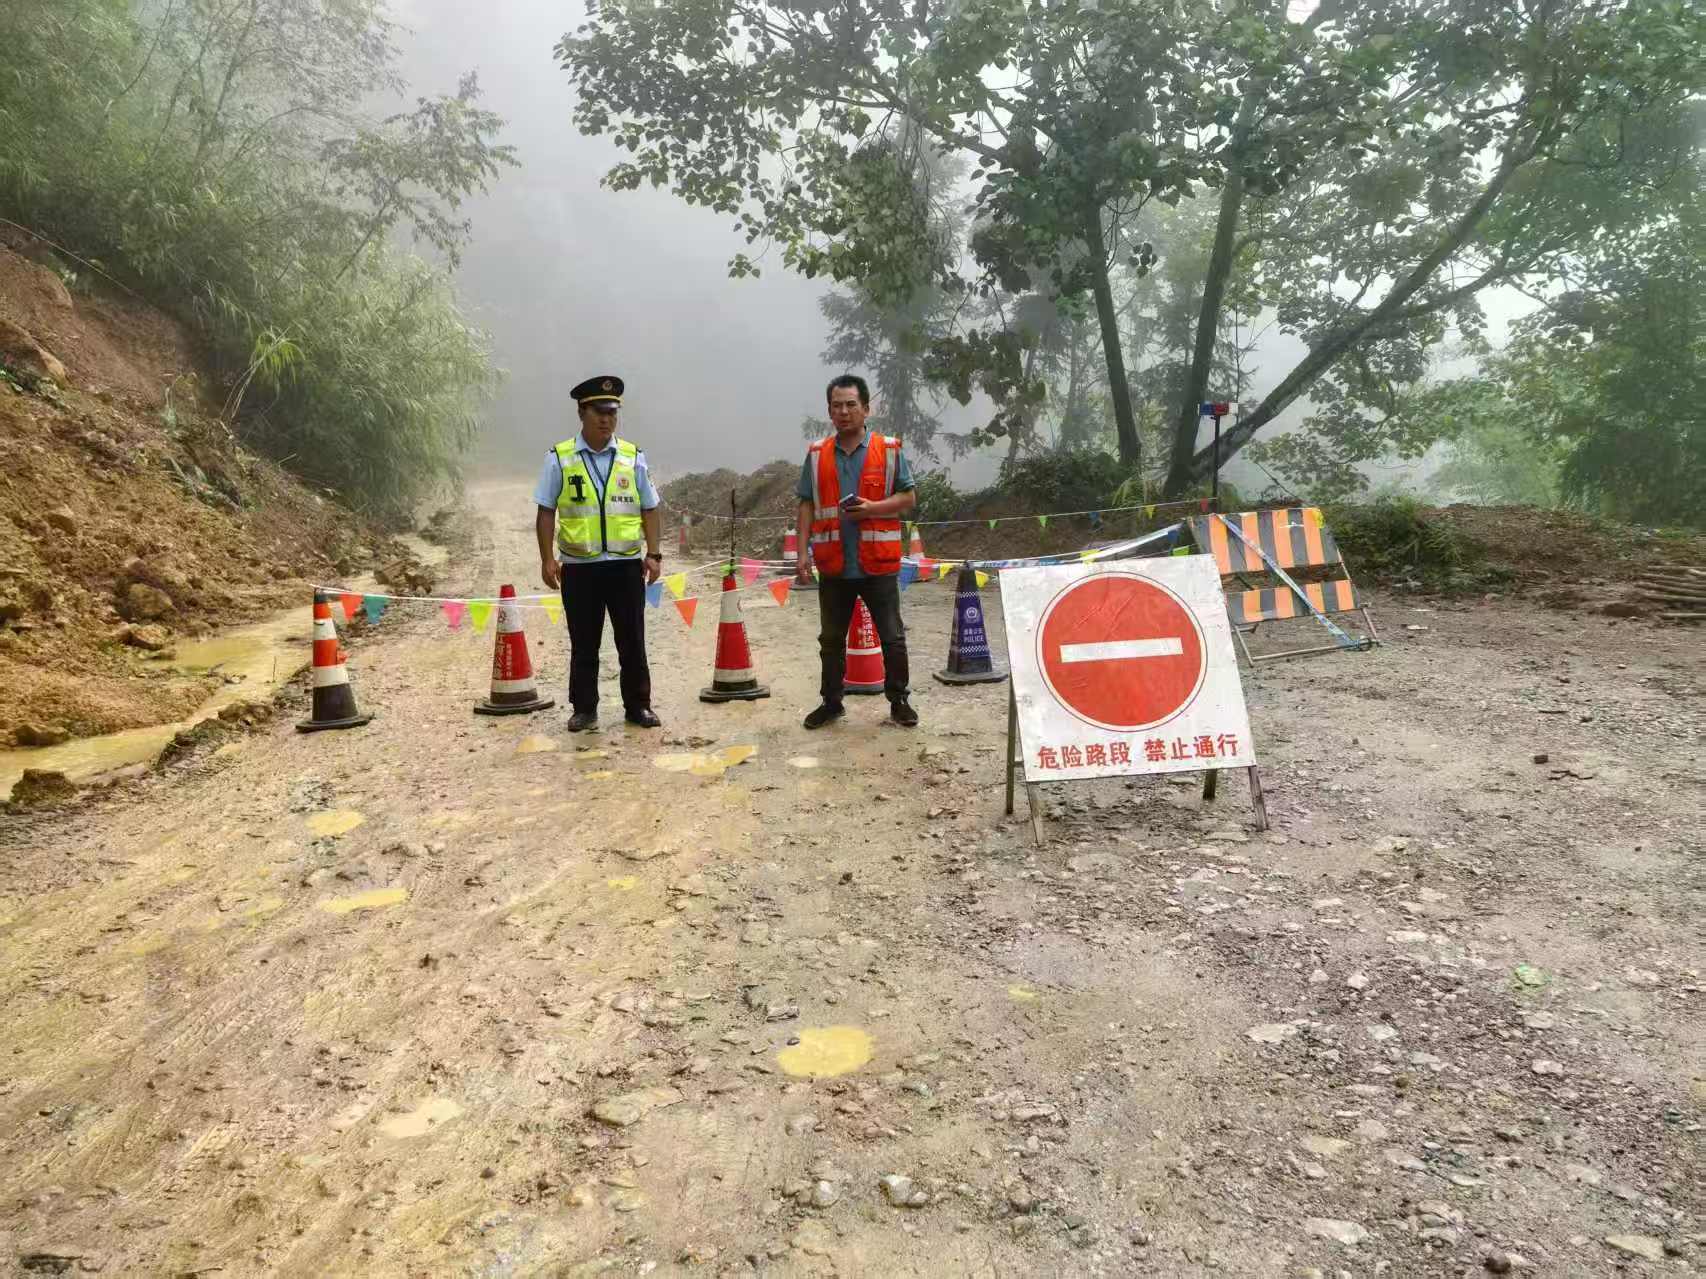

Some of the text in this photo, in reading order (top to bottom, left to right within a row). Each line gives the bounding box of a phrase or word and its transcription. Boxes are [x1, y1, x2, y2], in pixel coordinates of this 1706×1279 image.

[963, 634, 982, 643] POLICE
[1037, 733, 1238, 769] 危险路段 禁止通行
